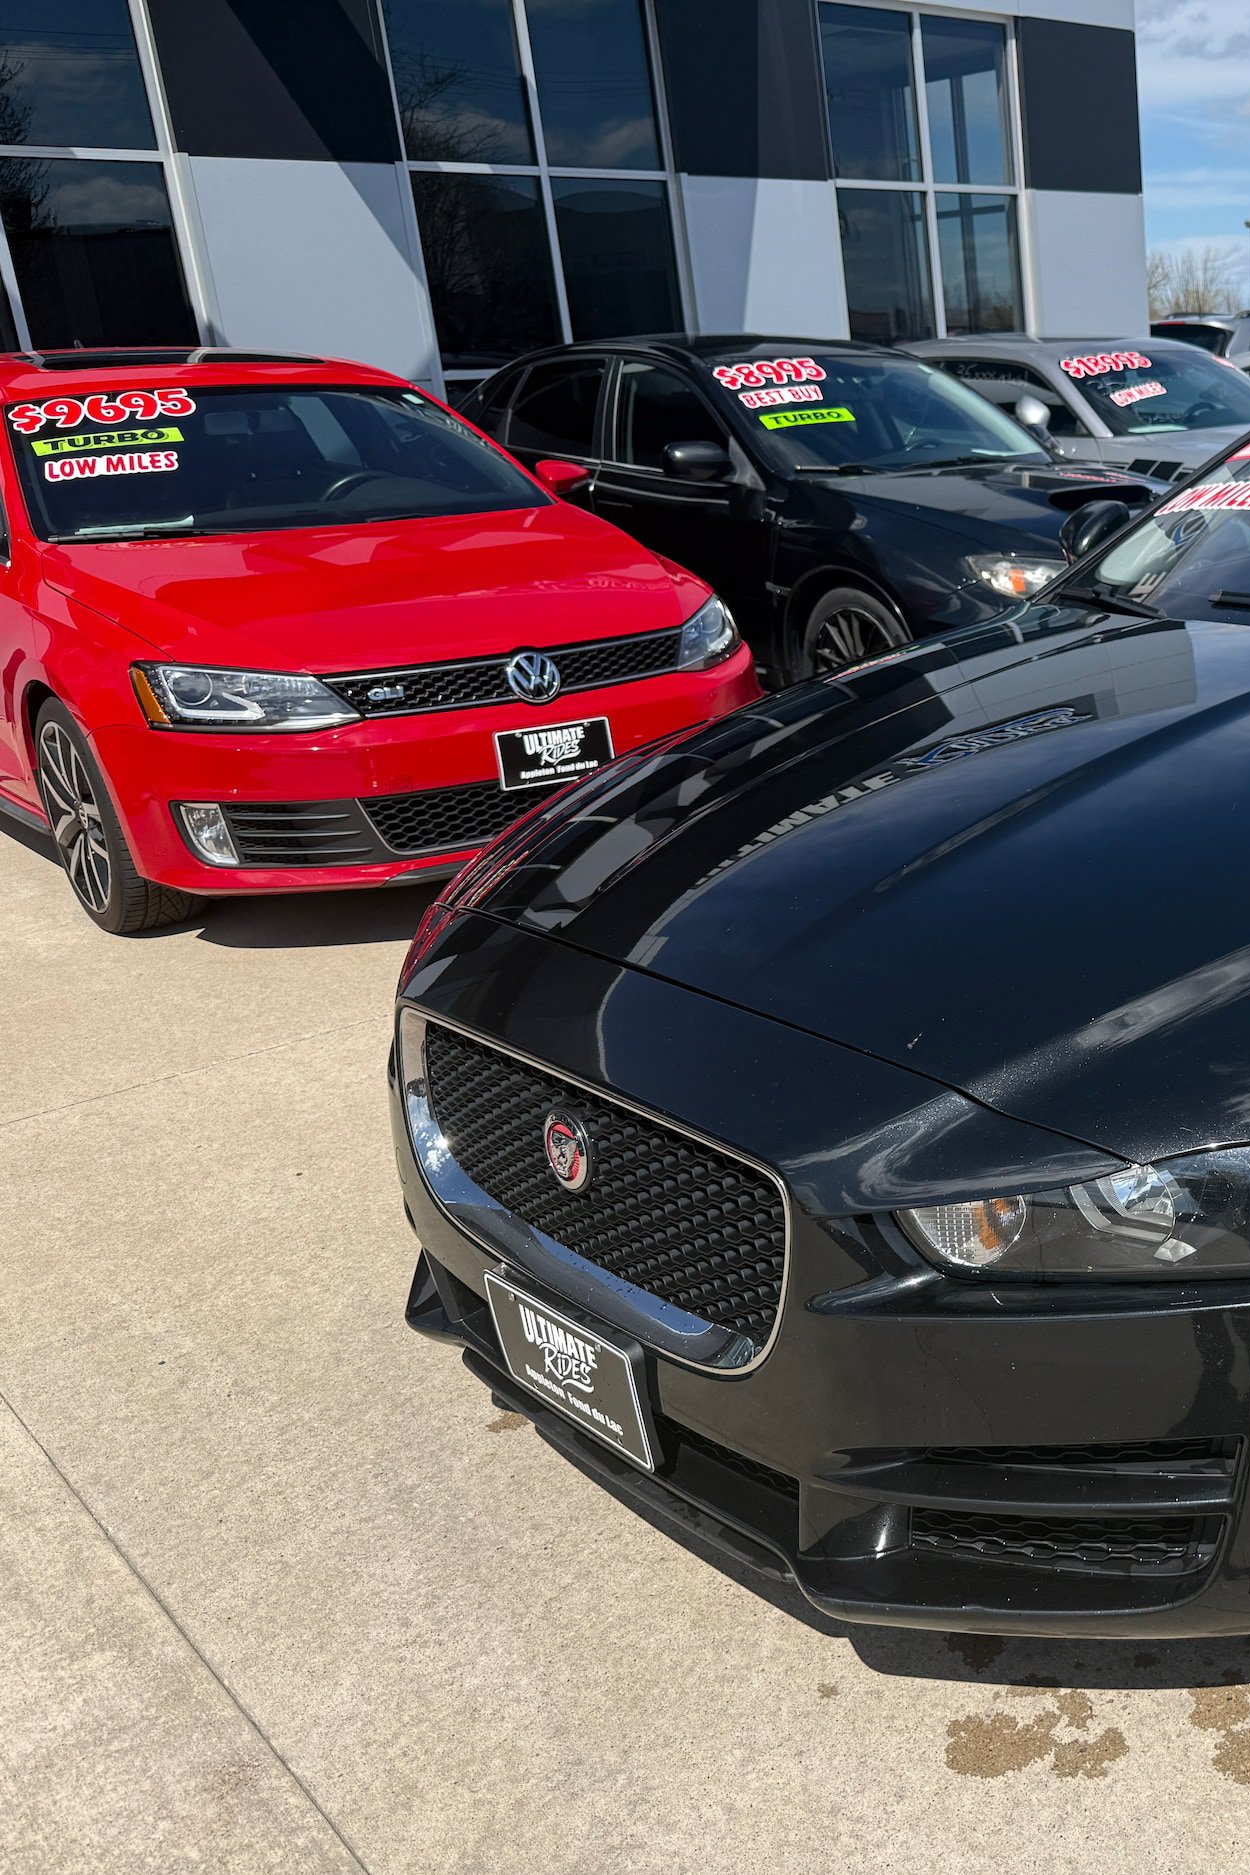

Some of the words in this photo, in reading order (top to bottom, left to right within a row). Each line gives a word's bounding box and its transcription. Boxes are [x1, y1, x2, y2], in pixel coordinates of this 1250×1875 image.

[713, 357, 827, 389] $8995
[1060, 352, 1152, 378] $18995
[741, 390, 785, 408] BEST
[787, 385, 820, 400] BUY
[9, 388, 196, 433] $9695
[769, 411, 842, 426] TURBO
[43, 430, 169, 450] TURBO
[48, 459, 97, 479] LOW
[106, 453, 176, 472] MILES
[523, 726, 585, 755] ULTIMATE
[520, 767, 555, 779] Appleton
[518, 1304, 598, 1369] ULTIMATE
[525, 1363, 565, 1399] Appleton
[566, 1391, 591, 1417] Fond
[592, 1407, 606, 1425] du
[605, 1414, 624, 1436] Lac
